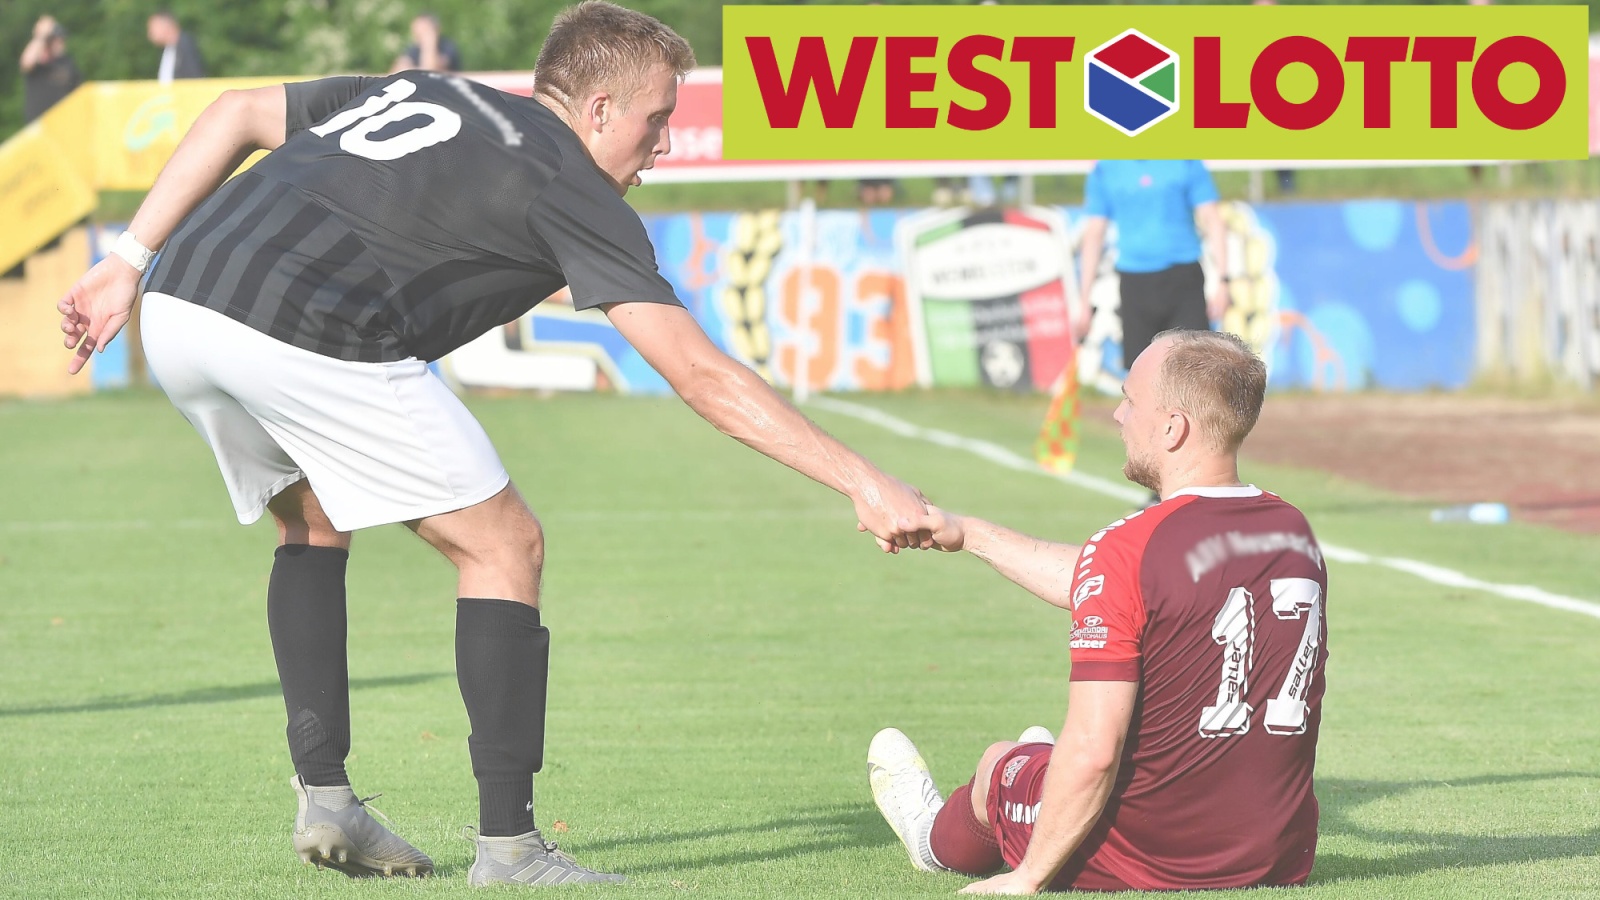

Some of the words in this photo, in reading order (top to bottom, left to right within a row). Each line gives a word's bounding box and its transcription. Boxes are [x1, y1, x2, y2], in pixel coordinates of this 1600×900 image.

[309, 78, 462, 161] 10
[779, 264, 917, 390] 93
[1199, 577, 1323, 738] 17
